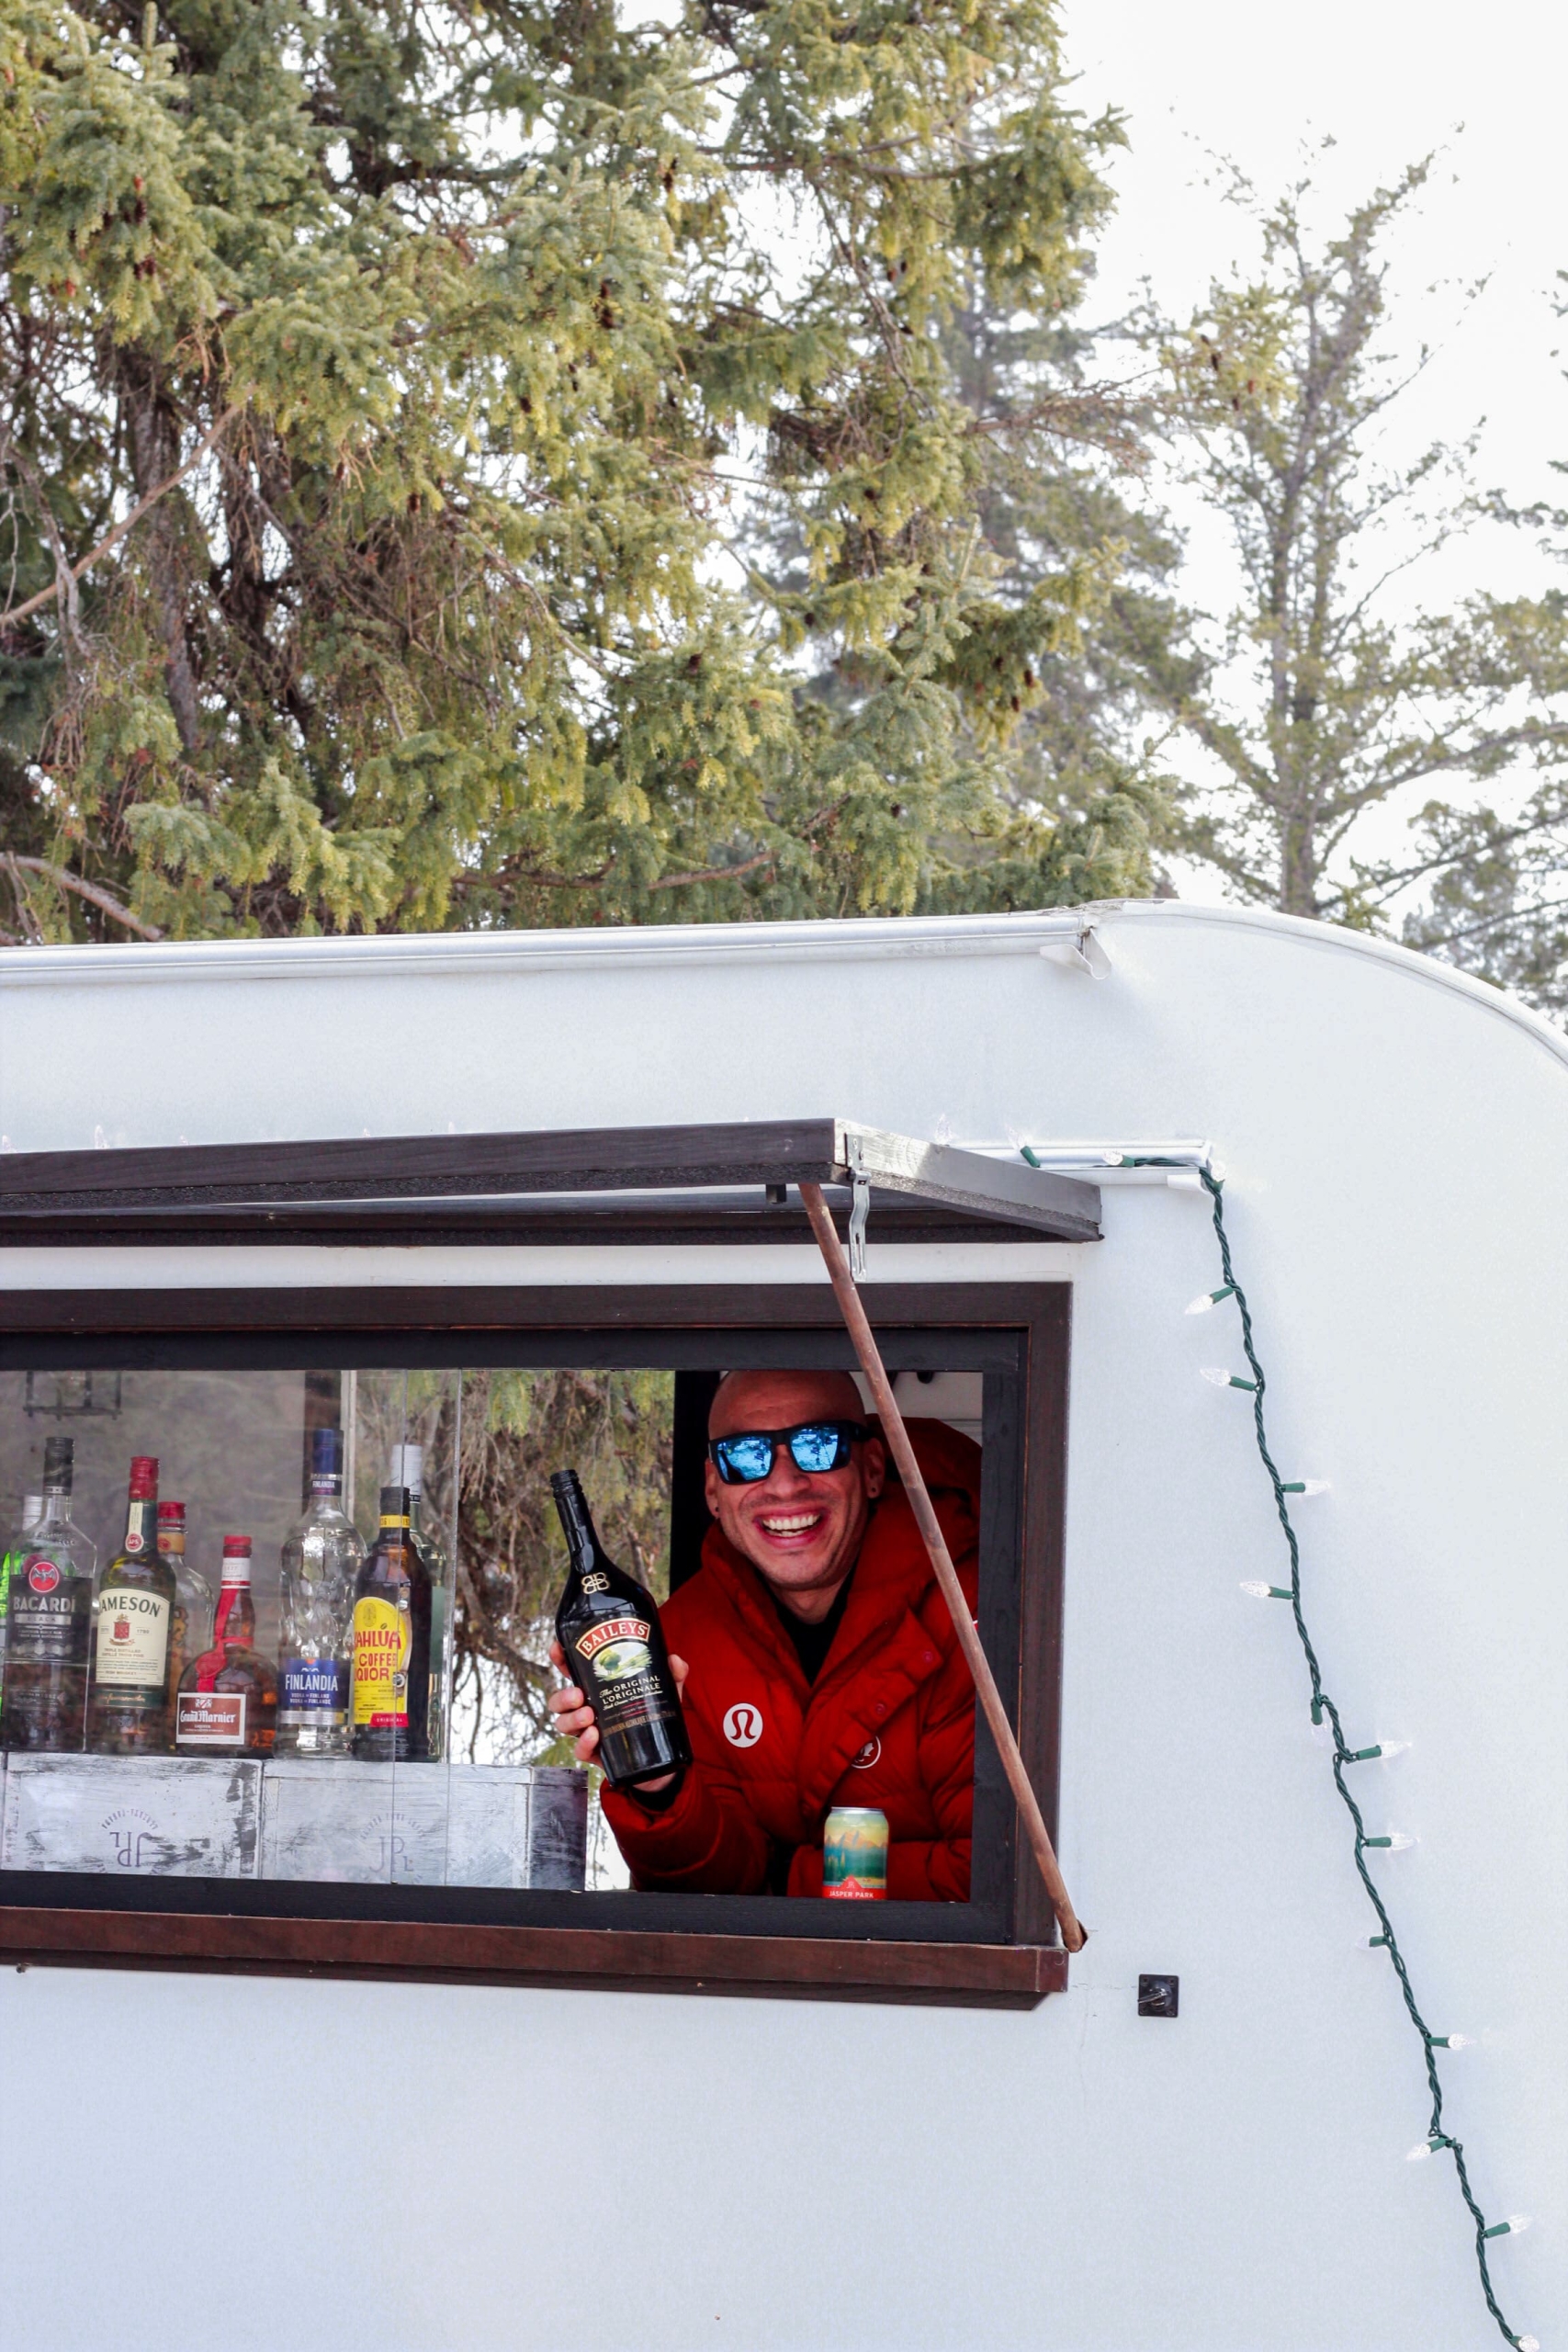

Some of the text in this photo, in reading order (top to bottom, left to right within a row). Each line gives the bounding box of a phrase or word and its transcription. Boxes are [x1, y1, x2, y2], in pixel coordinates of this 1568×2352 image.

[581, 1622, 648, 1653] BAILEYS
[285, 1674, 339, 1691] FINLANDIA
[613, 1675, 660, 1692] ORIGINAL
[602, 1682, 660, 1705] L'ORIGINALE
[198, 1710, 236, 1724] Marnier
[854, 1891, 874, 1899] PARK
